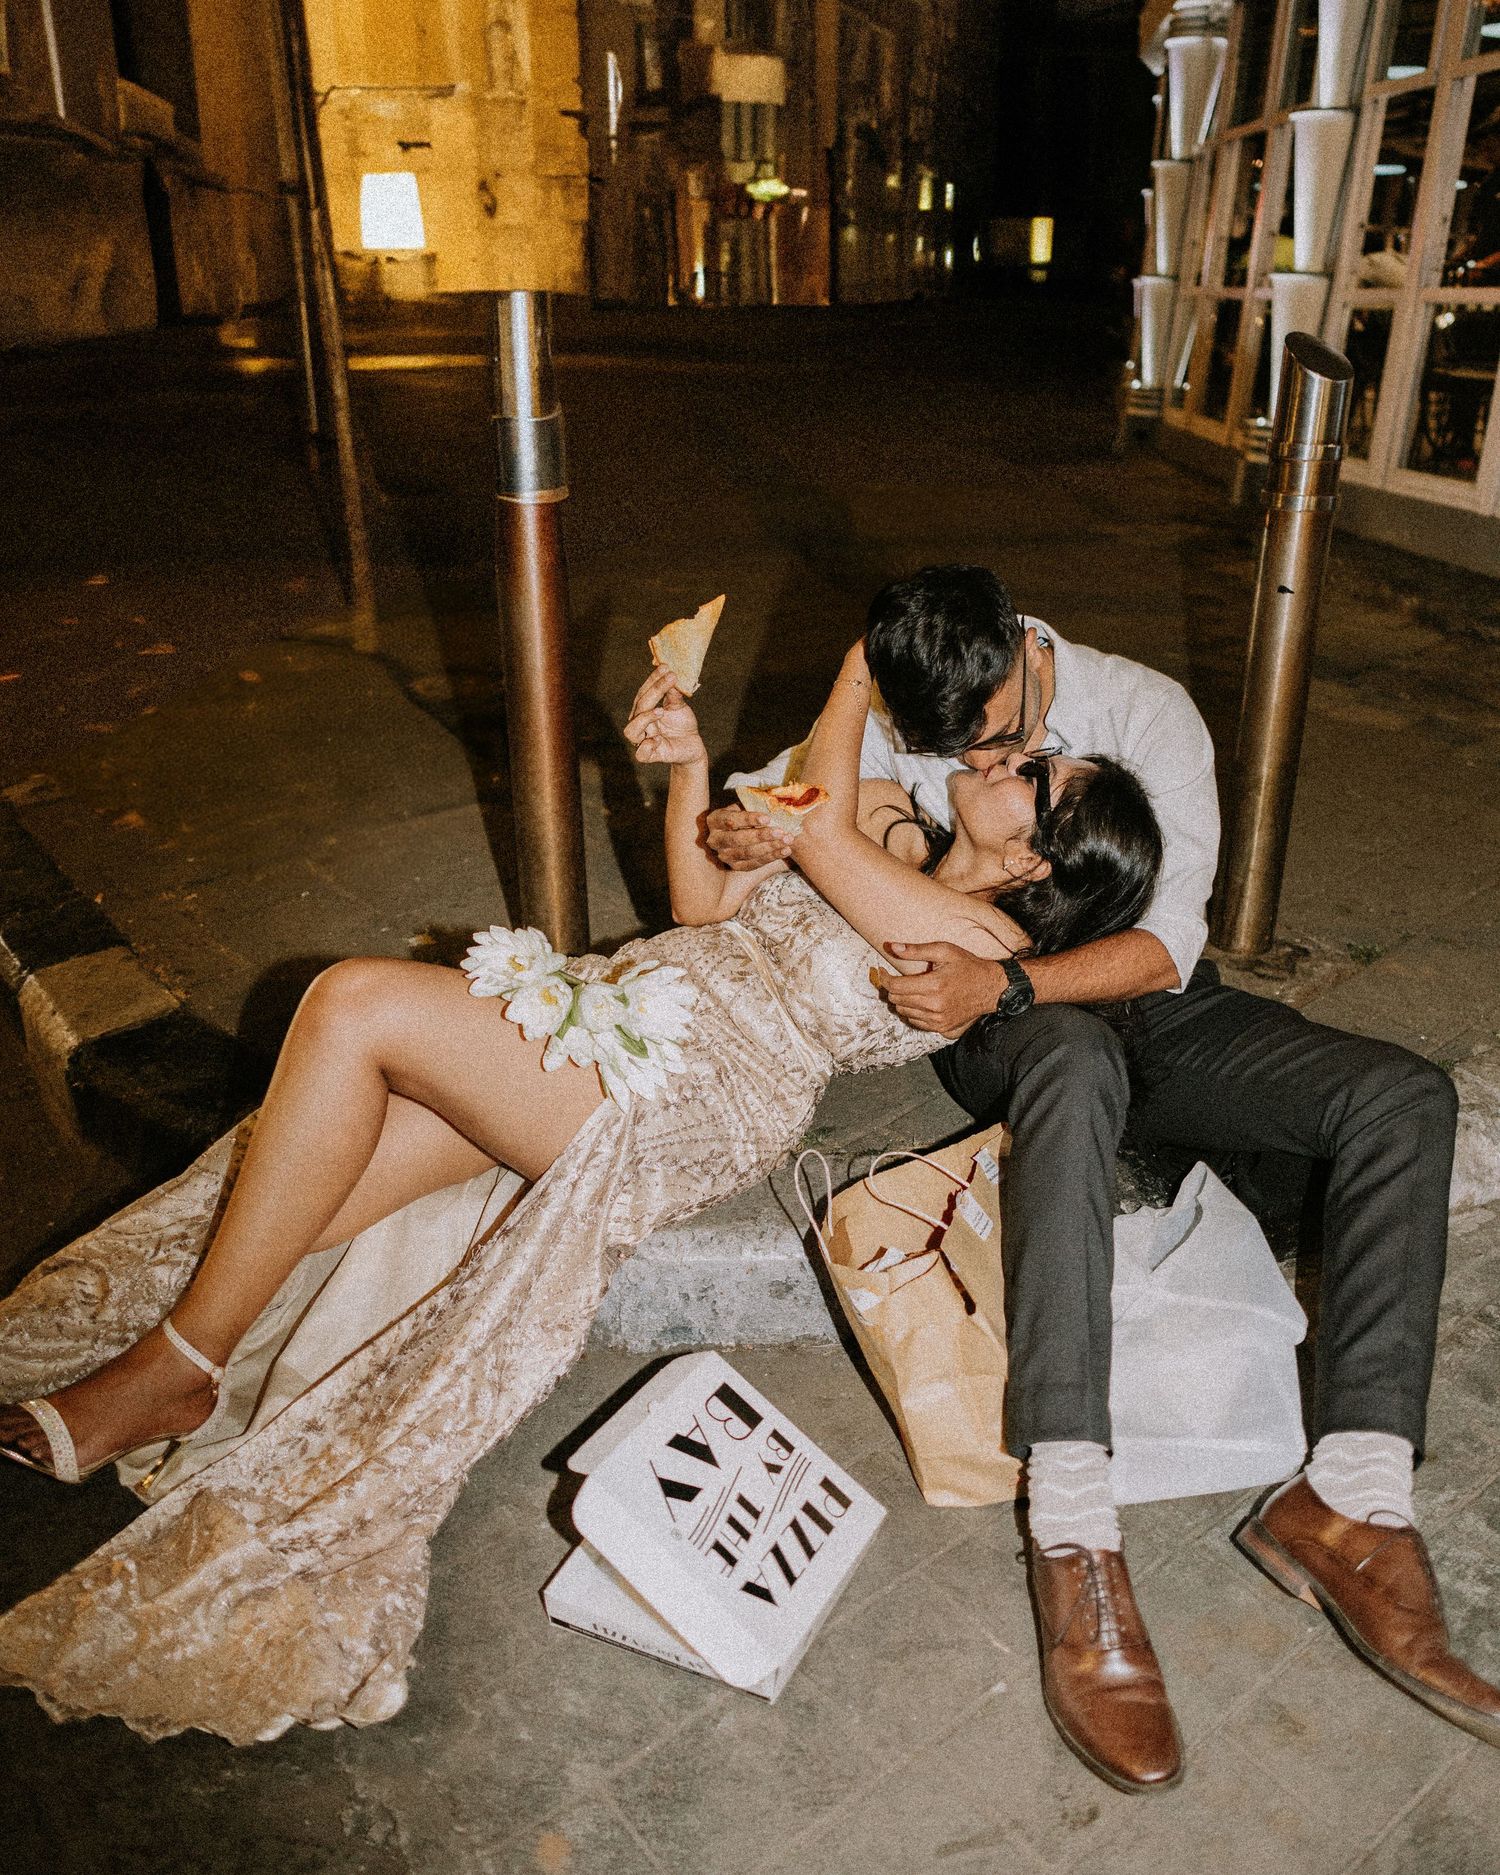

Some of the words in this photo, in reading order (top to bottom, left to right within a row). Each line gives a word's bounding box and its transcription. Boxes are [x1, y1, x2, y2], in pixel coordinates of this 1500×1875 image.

[649, 1382, 764, 1523] BAY
[758, 1428, 796, 1485] BY
[704, 1492, 765, 1578] THE
[739, 1475, 853, 1607] PIZZA
